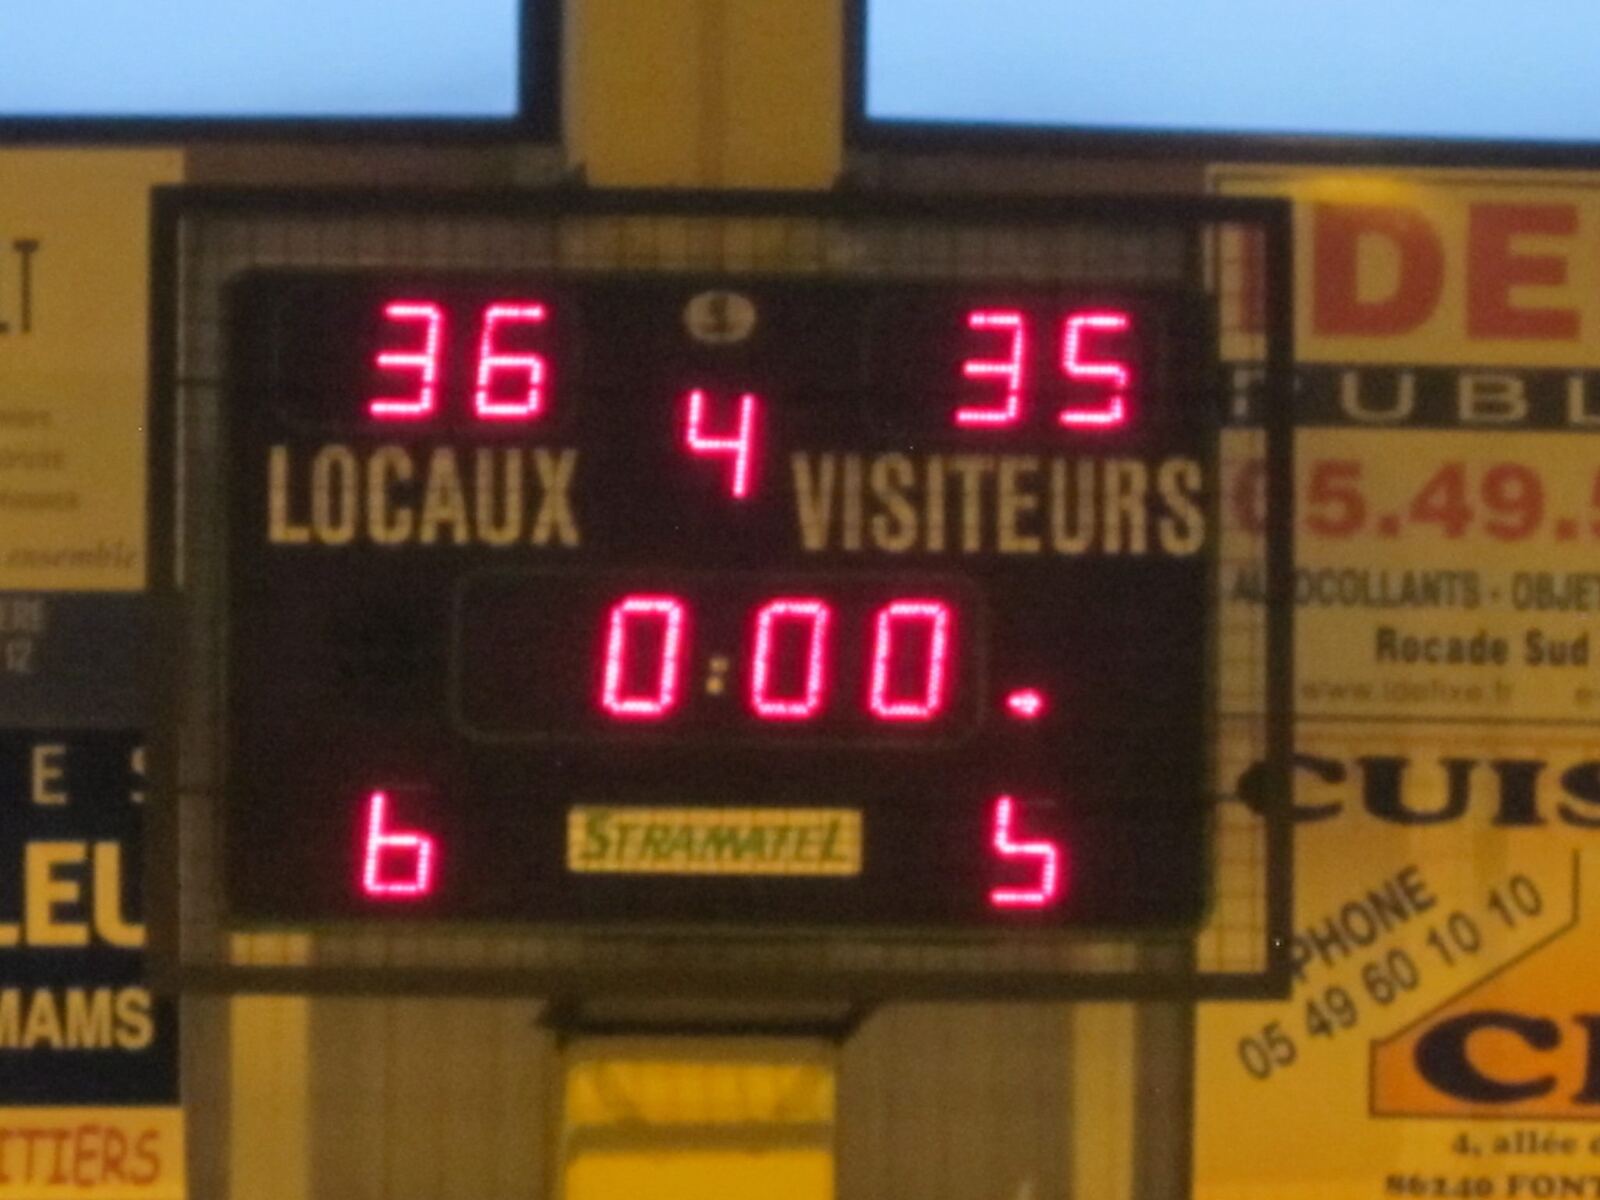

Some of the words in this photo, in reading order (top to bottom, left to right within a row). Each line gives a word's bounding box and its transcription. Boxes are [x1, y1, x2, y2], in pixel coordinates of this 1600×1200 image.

[366, 302, 548, 420] 36
[951, 307, 1132, 428] 35
[266, 443, 581, 549] LOCAUX
[682, 388, 759, 500] 4
[791, 450, 1207, 557] VISITEURS
[1231, 457, 1600, 542] 05.49.
[1232, 565, 1480, 612] AOCOLLANTS
[1375, 626, 1510, 668] Rocade
[1524, 627, 1590, 668] Sud
[362, 792, 435, 898] 6
[578, 808, 852, 868] STRAMATEL
[988, 796, 1066, 908] 5
[1236, 1018, 1297, 1081] 05
[1304, 985, 1358, 1038] 49
[1360, 948, 1420, 1006] 60
[1426, 911, 1481, 966] 10
[1487, 873, 1543, 929] 10
